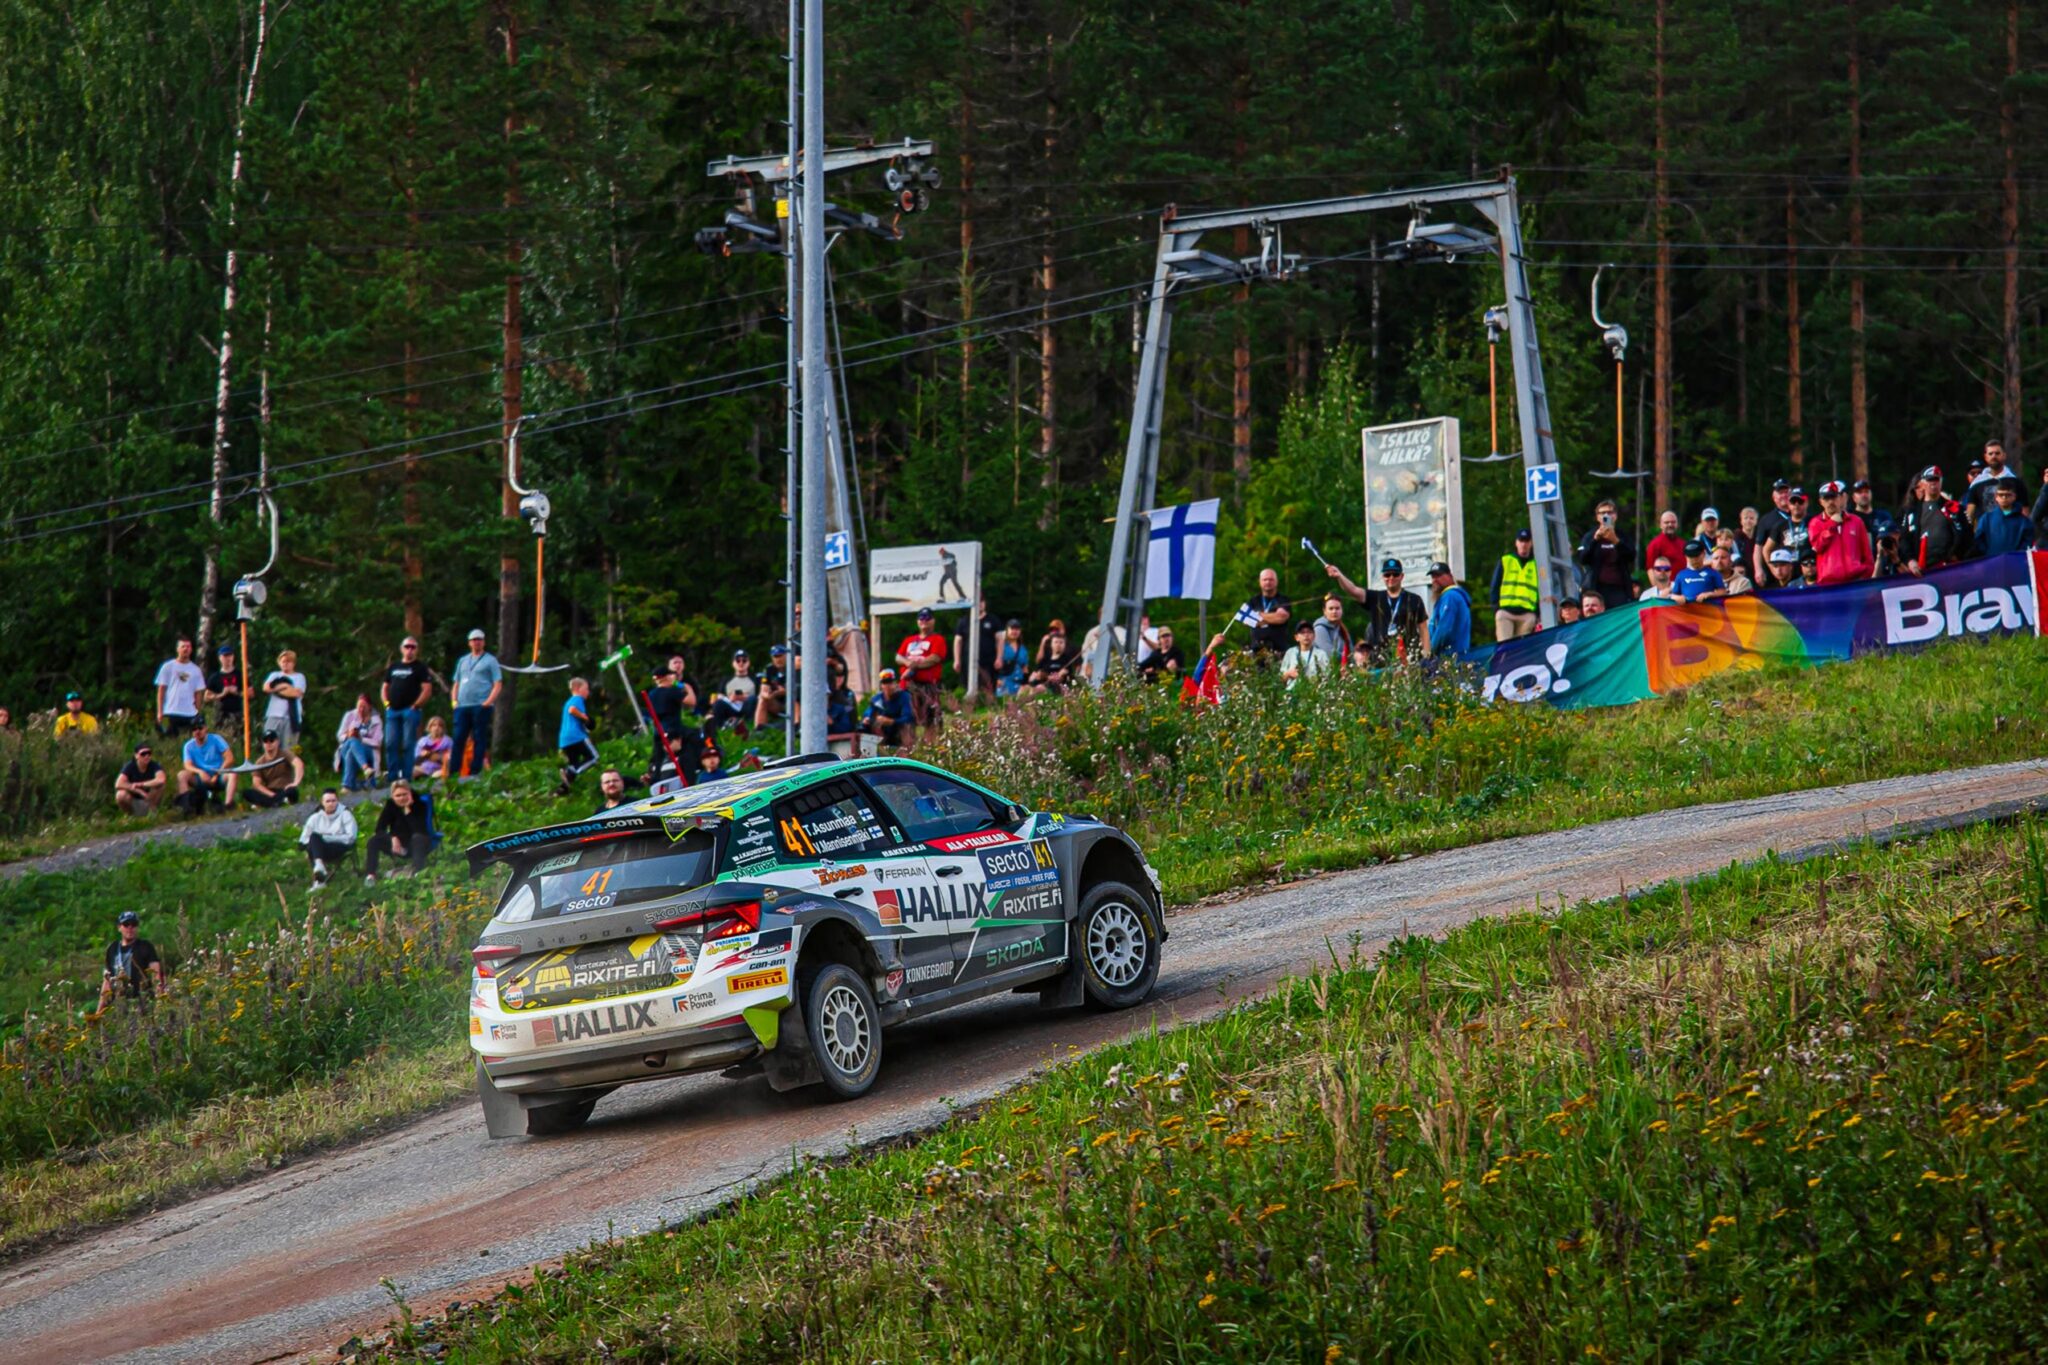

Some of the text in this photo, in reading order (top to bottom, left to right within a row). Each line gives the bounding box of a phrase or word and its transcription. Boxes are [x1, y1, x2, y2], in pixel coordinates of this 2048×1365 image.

[484, 817, 644, 853] Tuningkauppa.com
[780, 816, 816, 856] 41
[802, 814, 857, 837] T.Asunmaa
[986, 850, 1030, 875] secto
[1035, 843, 1053, 867] 41
[581, 868, 613, 896] 41
[885, 867, 926, 879] FERRAIN
[1044, 871, 1057, 880] FUEL
[566, 894, 610, 911] secto
[895, 882, 991, 924] HALLIX
[1003, 888, 1063, 916] RIXITE.fi
[574, 960, 656, 987] RIXITE.fi
[672, 964, 694, 973] Gulf
[749, 958, 786, 970] can-am
[906, 961, 954, 984] KONNEGROUP
[732, 971, 783, 991] PIRELLI
[688, 991, 713, 1001] Prima
[690, 999, 717, 1011] Power
[553, 1000, 656, 1042] HALLIX
